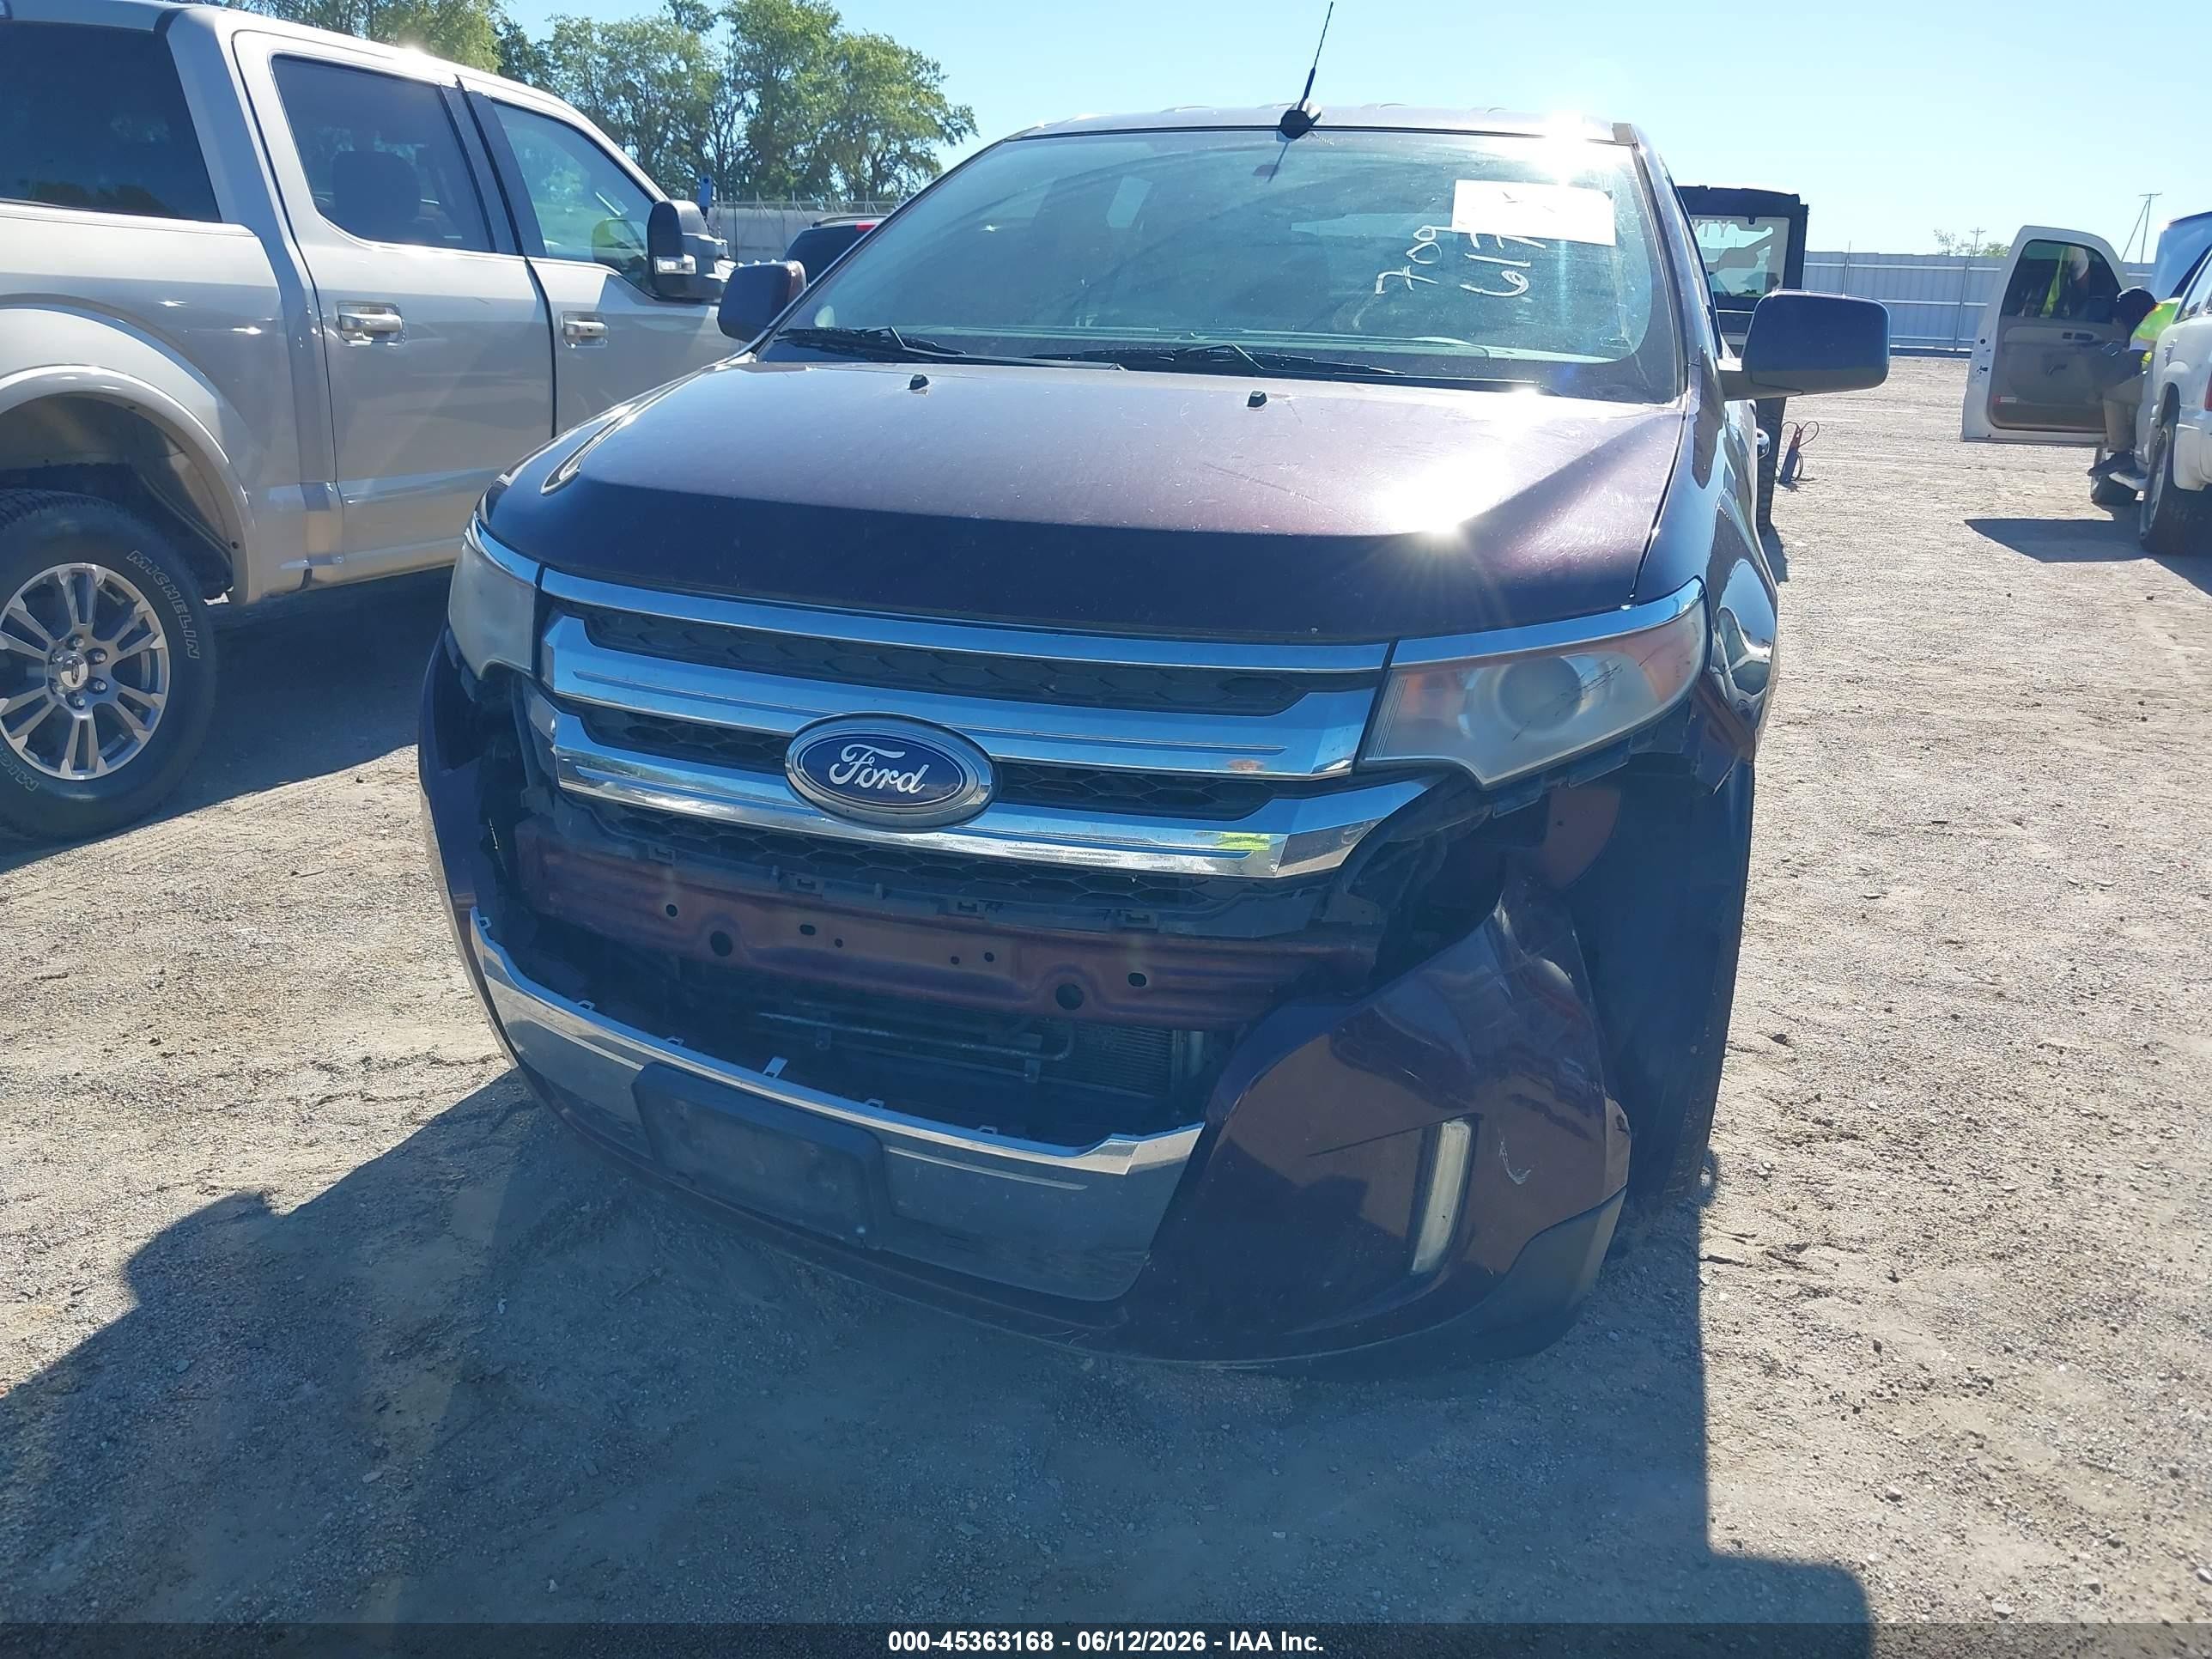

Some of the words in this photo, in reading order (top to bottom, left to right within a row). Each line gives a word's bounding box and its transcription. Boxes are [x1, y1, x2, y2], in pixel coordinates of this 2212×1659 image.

[1692, 220, 1732, 238] ITY
[1375, 225, 1453, 295] 709
[125, 550, 200, 659] MICHELIN
[0, 749, 40, 792] MIC
[829, 743, 929, 794] Ford
